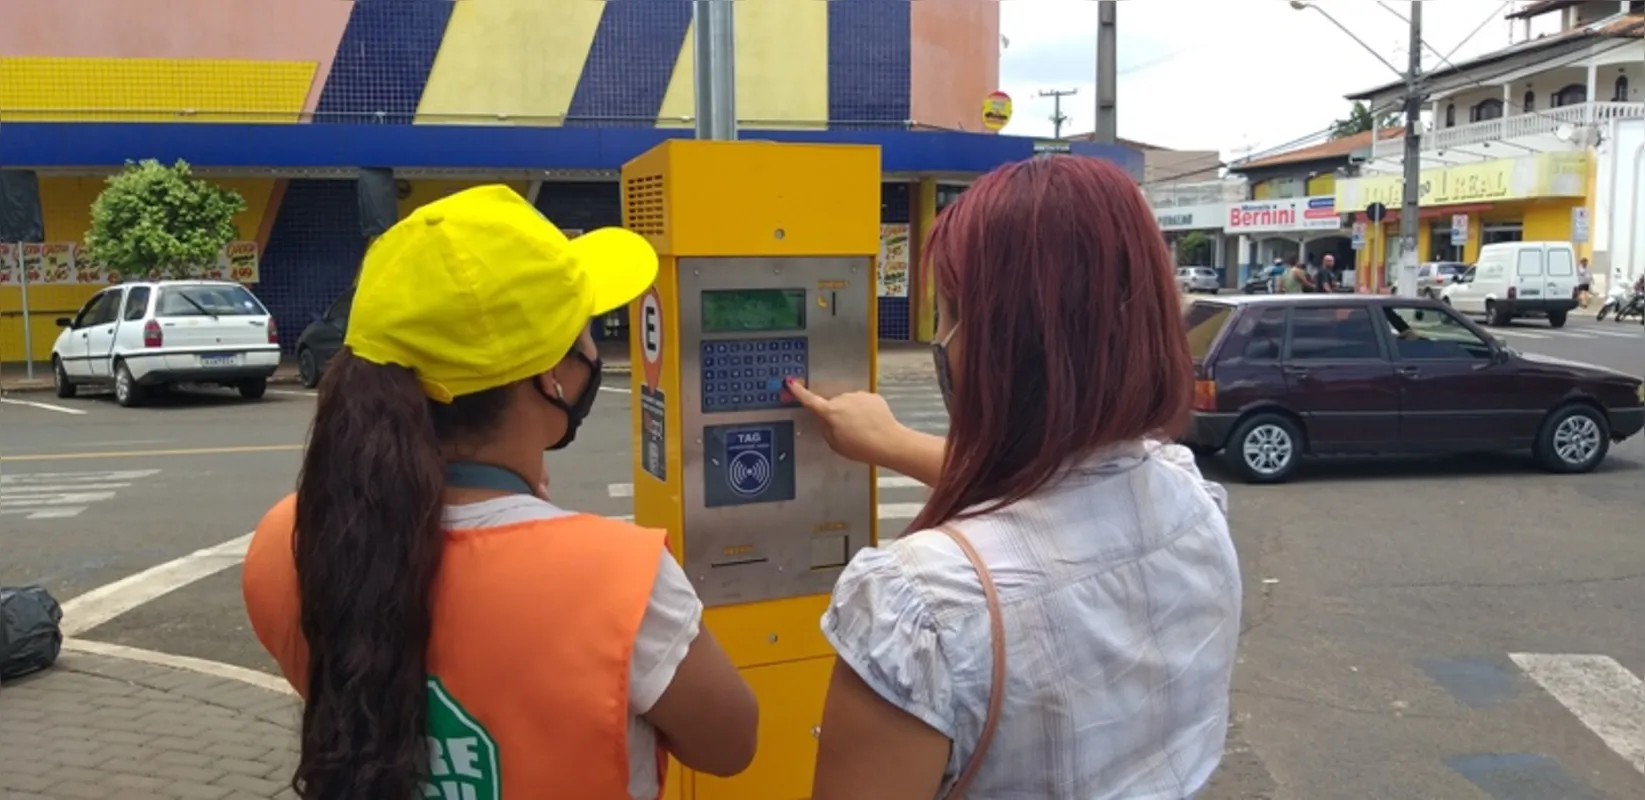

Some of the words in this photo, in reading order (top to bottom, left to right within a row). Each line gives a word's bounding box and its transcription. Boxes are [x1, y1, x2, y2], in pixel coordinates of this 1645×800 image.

[1453, 170, 1507, 199] REAL
[1230, 203, 1296, 227] Bernini
[645, 305, 658, 352] E
[737, 432, 762, 444] TAG
[426, 735, 483, 780] RE
